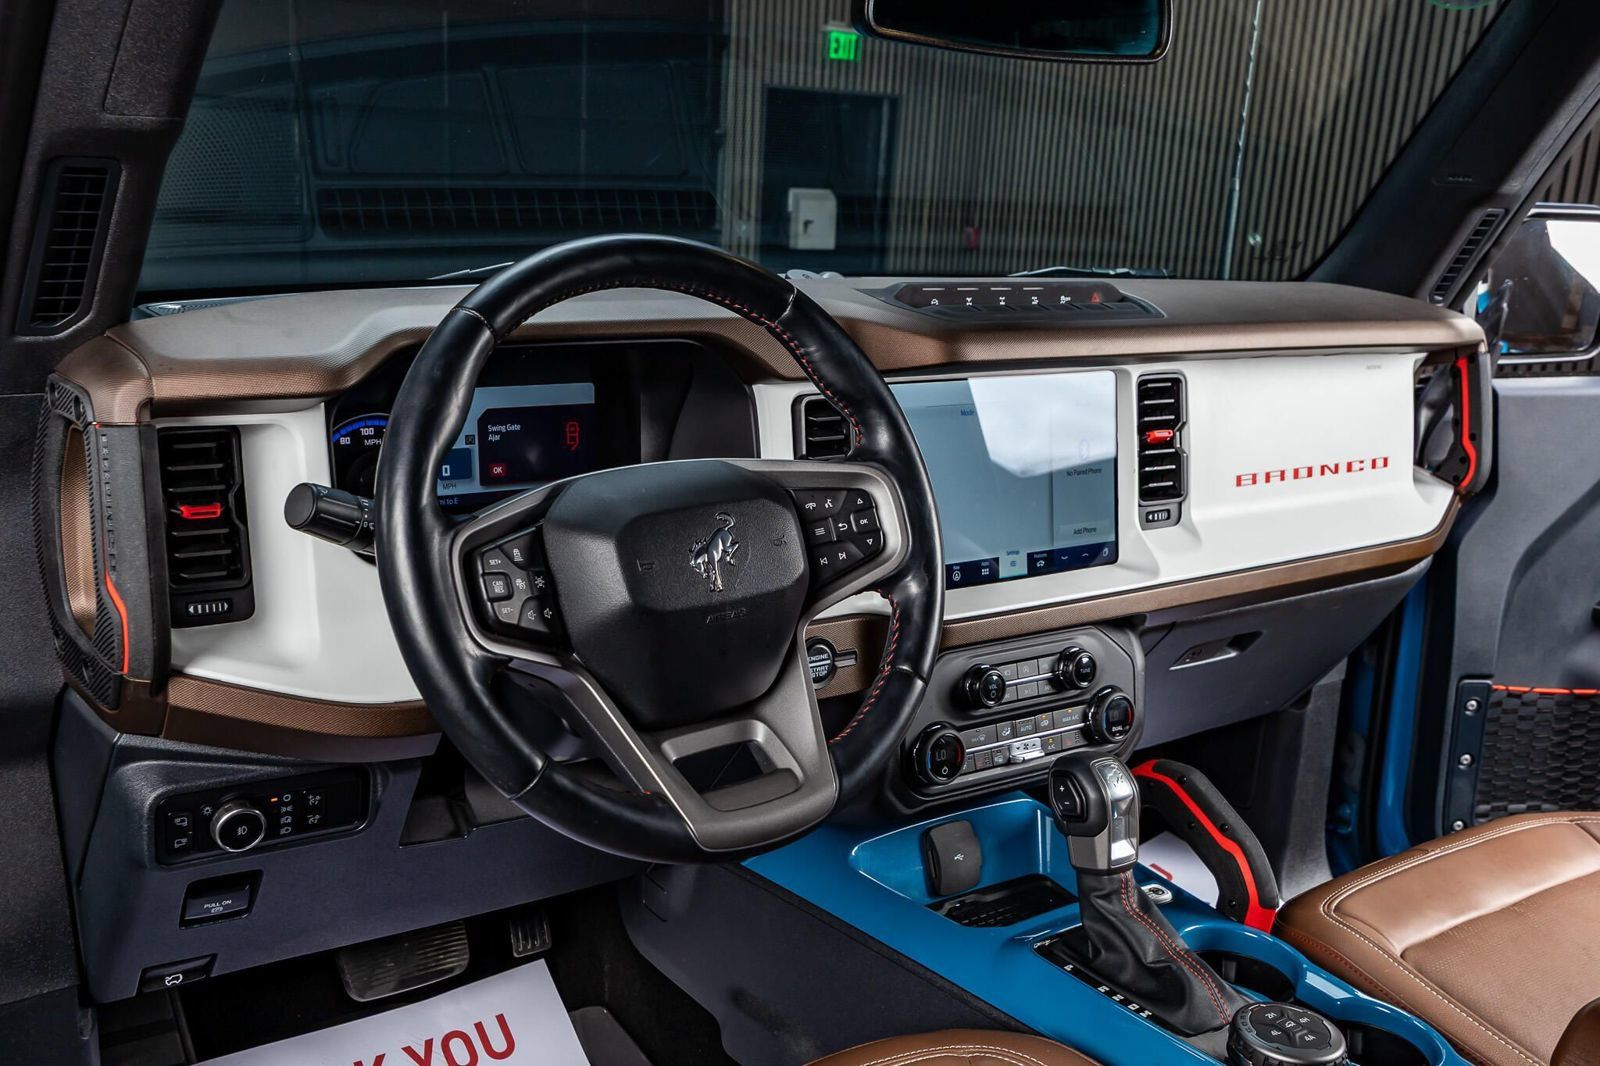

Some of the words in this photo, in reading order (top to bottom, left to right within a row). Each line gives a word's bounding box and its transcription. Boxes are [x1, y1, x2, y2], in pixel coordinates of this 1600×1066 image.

[829, 31, 857, 60] EXIT
[360, 428, 374, 436] 100
[487, 424, 506, 433] Swing
[506, 423, 521, 431] Gate
[340, 437, 351, 445] 80
[488, 433, 501, 442] Ajar
[364, 438, 382, 446] MPH
[493, 466, 503, 474] OK
[1235, 456, 1389, 487] BRONCO
[442, 483, 457, 491] MPH
[454, 497, 459, 505] E
[808, 652, 829, 662] ENGINE
[810, 664, 829, 673] START
[811, 670, 828, 678] STOP
[1020, 723, 1033, 732] AUTO
[935, 749, 947, 761] LO
[1265, 1011, 1278, 1019] 2H
[1299, 1016, 1311, 1024] 4H
[401, 1013, 516, 1066] YOU
[1304, 1034, 1317, 1042] 4A
